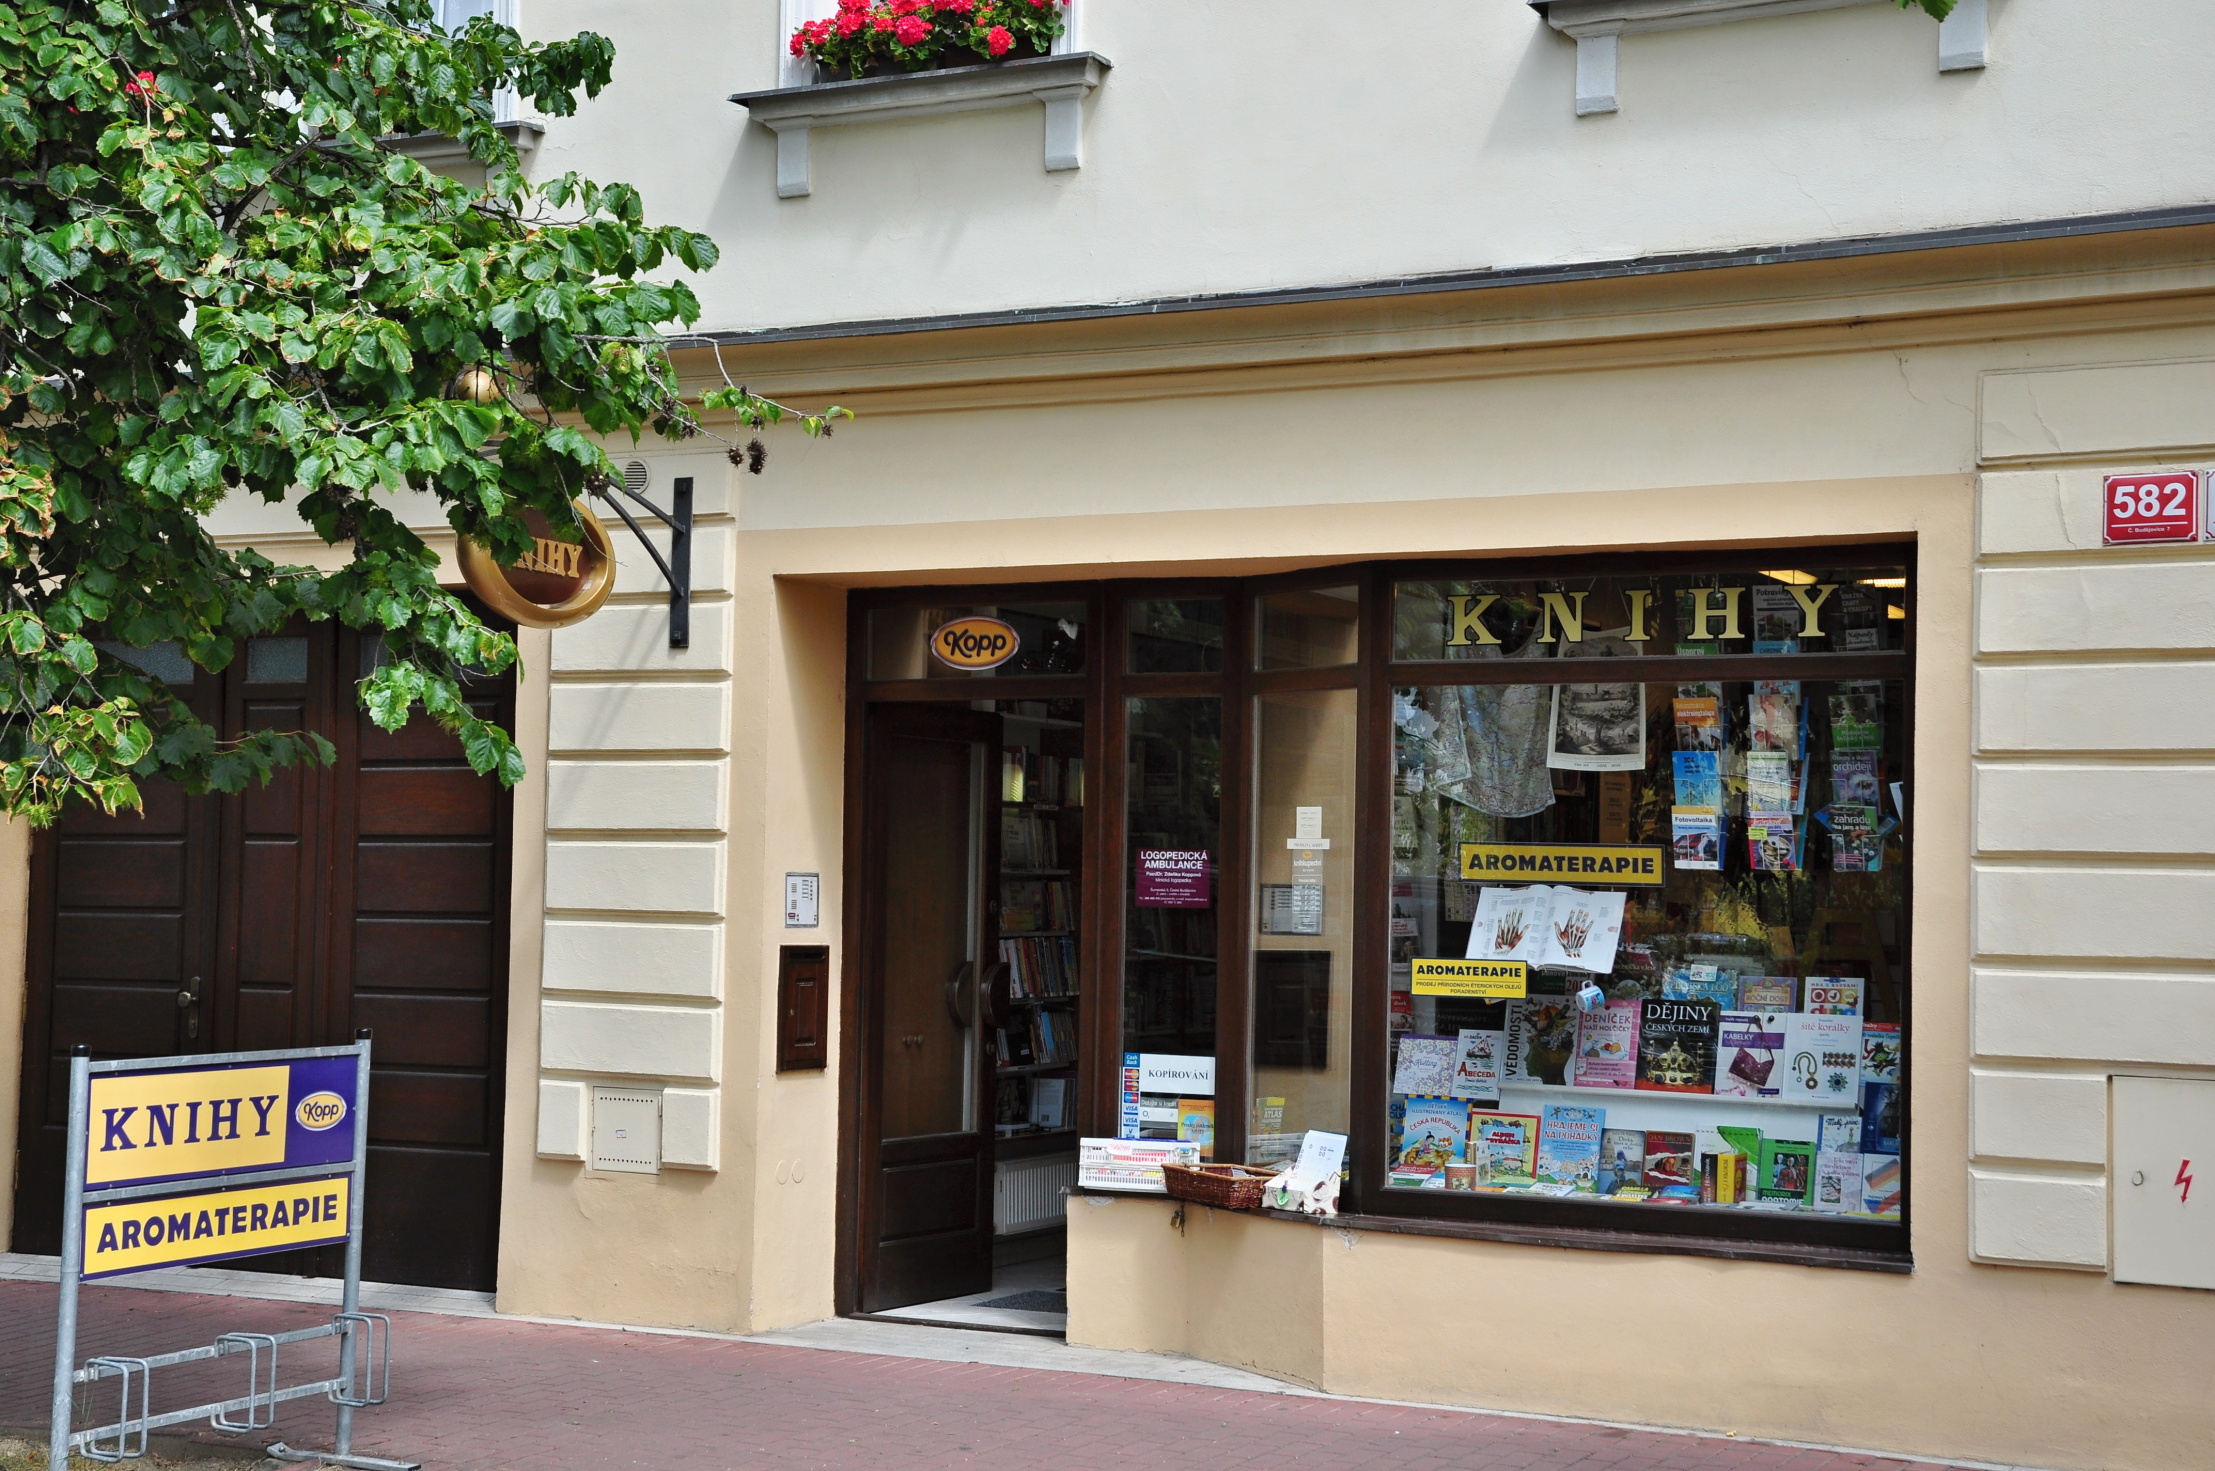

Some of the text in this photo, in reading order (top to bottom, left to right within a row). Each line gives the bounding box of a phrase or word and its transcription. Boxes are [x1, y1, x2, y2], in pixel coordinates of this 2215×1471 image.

[2112, 482, 2187, 519] 582
[513, 536, 583, 578] NIHY
[1446, 583, 1840, 646] KNIHY
[944, 628, 1007, 658] Kopp
[1833, 814, 1871, 824] zahradu
[1140, 849, 1208, 860] LOGOPEDICKÁ
[1144, 860, 1204, 870] AMBULANCE
[1468, 853, 1655, 875] AROMATERAPIE
[1416, 964, 1522, 978] AROMATERAPIE
[1437, 980, 1470, 989] PŘÍRODNÍCH
[1584, 1010, 1631, 1024] DENÍČEK
[1646, 1001, 1712, 1023] DĚJINY
[1599, 1024, 1630, 1033] HOLČIČKY
[1645, 1022, 1711, 1034] ČESKÝCH ZEMÍ
[1800, 1021, 1850, 1034] šité korálky
[1504, 1005, 1523, 1077] VĚDOMOSTI
[1723, 1032, 1754, 1041] KABELKY
[1148, 1067, 1209, 1080] KOPÍROVÁNÍ
[1457, 1061, 1496, 1078] ABECEDA
[303, 1097, 339, 1123] Kopp
[1263, 1110, 1282, 1119] ATLAS
[99, 1094, 280, 1152] KNIHY
[1409, 1116, 1461, 1135] ČESKÁ REPUBLIKA
[1546, 1120, 1599, 1132] HRAJEME SI
[1544, 1130, 1557, 1139] NA
[96, 1193, 338, 1255] AROMATERAPIE
